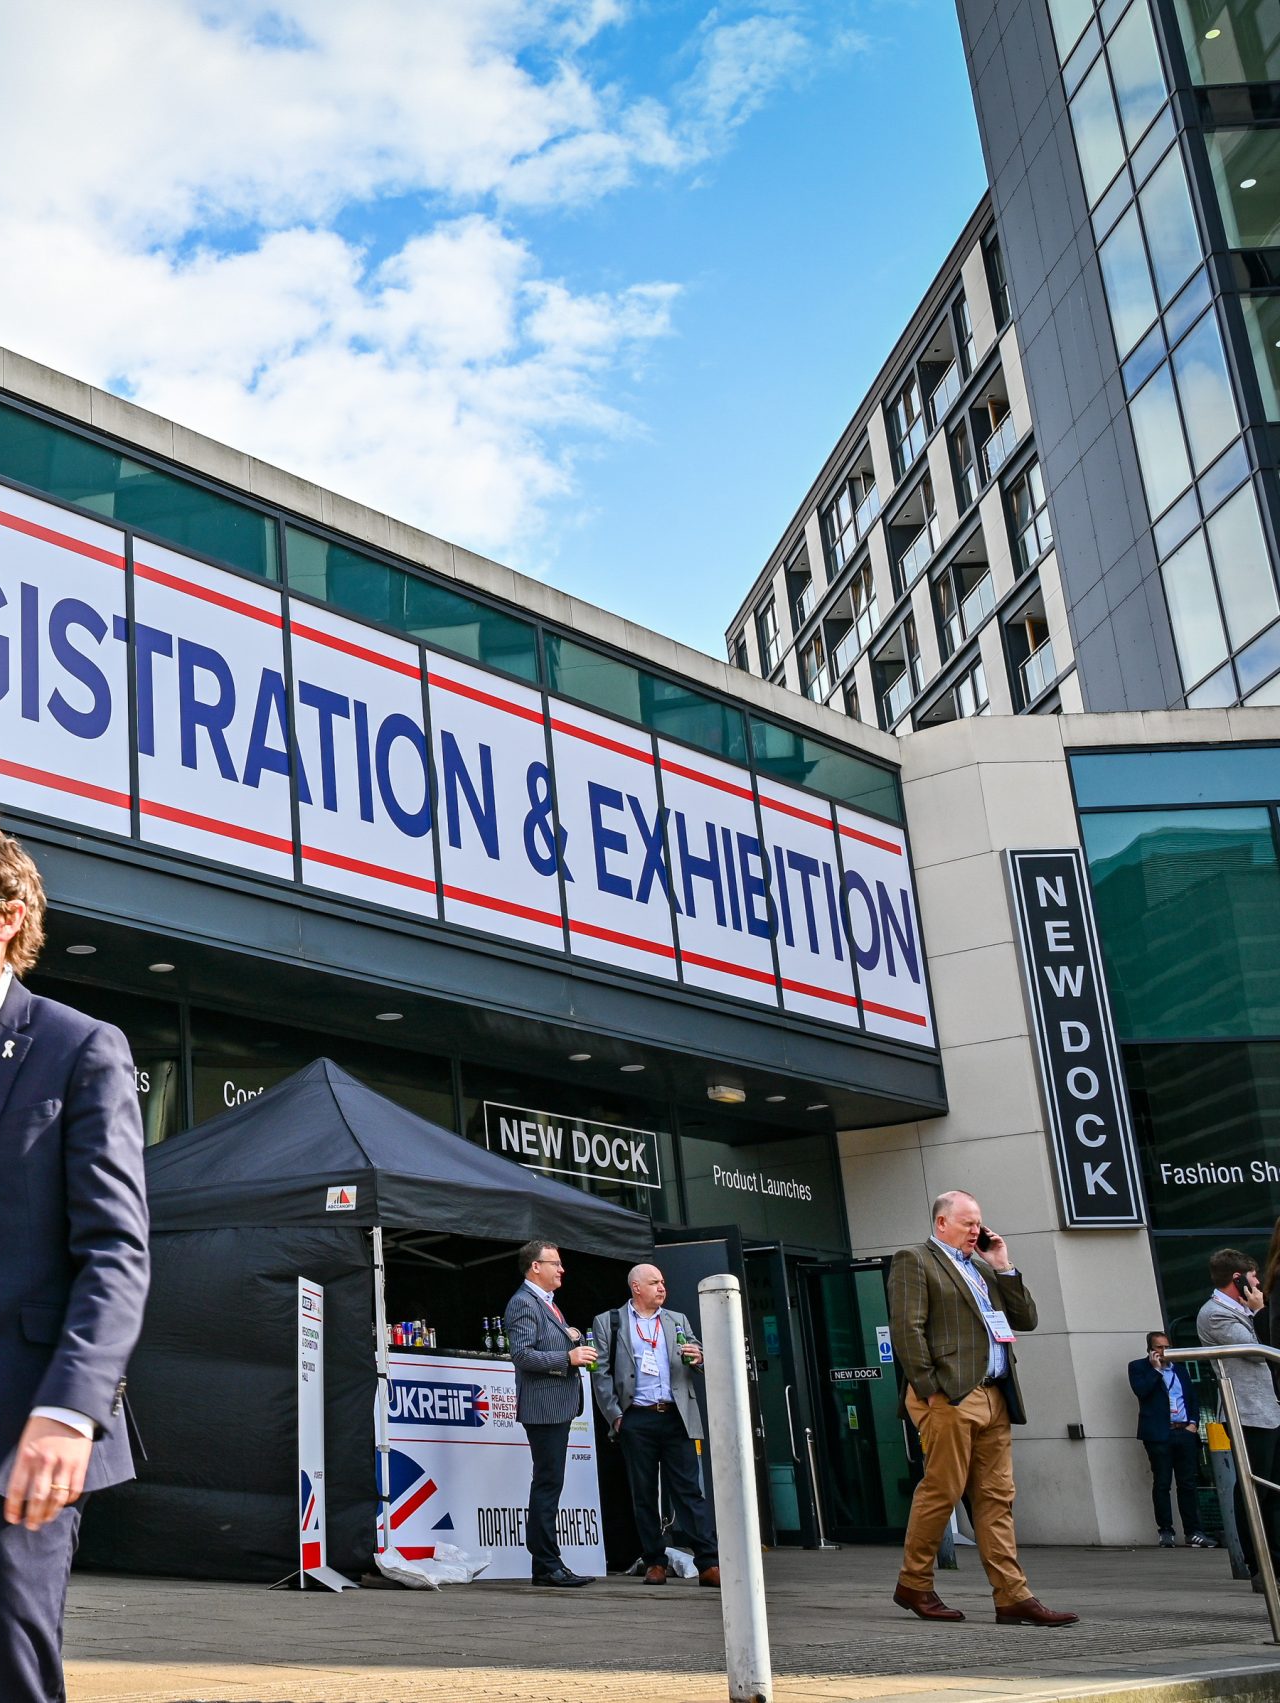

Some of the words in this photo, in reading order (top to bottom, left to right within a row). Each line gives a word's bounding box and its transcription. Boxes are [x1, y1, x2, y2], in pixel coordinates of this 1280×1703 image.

[523, 761, 575, 882] &
[587, 780, 920, 985] EXHIBITION
[1035, 876, 1085, 998] NEW
[1059, 1020, 1118, 1196] DOCK
[499, 1116, 563, 1160] NEW
[572, 1130, 650, 1175] DOCK
[713, 1165, 758, 1193] Product
[760, 1173, 812, 1201] Launches
[1160, 1161, 1244, 1184] Fashion
[1250, 1161, 1280, 1183] Sh
[834, 1370, 852, 1379] NEW
[854, 1369, 878, 1378] DOCK
[387, 1386, 472, 1420] UKREiiF
[491, 1385, 501, 1394] THE
[491, 1395, 505, 1403] REAL
[507, 1395, 518, 1403] EST
[492, 1402, 517, 1411] INVESTM
[493, 1411, 517, 1420] INFRAST
[493, 1419, 514, 1428] FORUM
[477, 1507, 530, 1547] NORTHE
